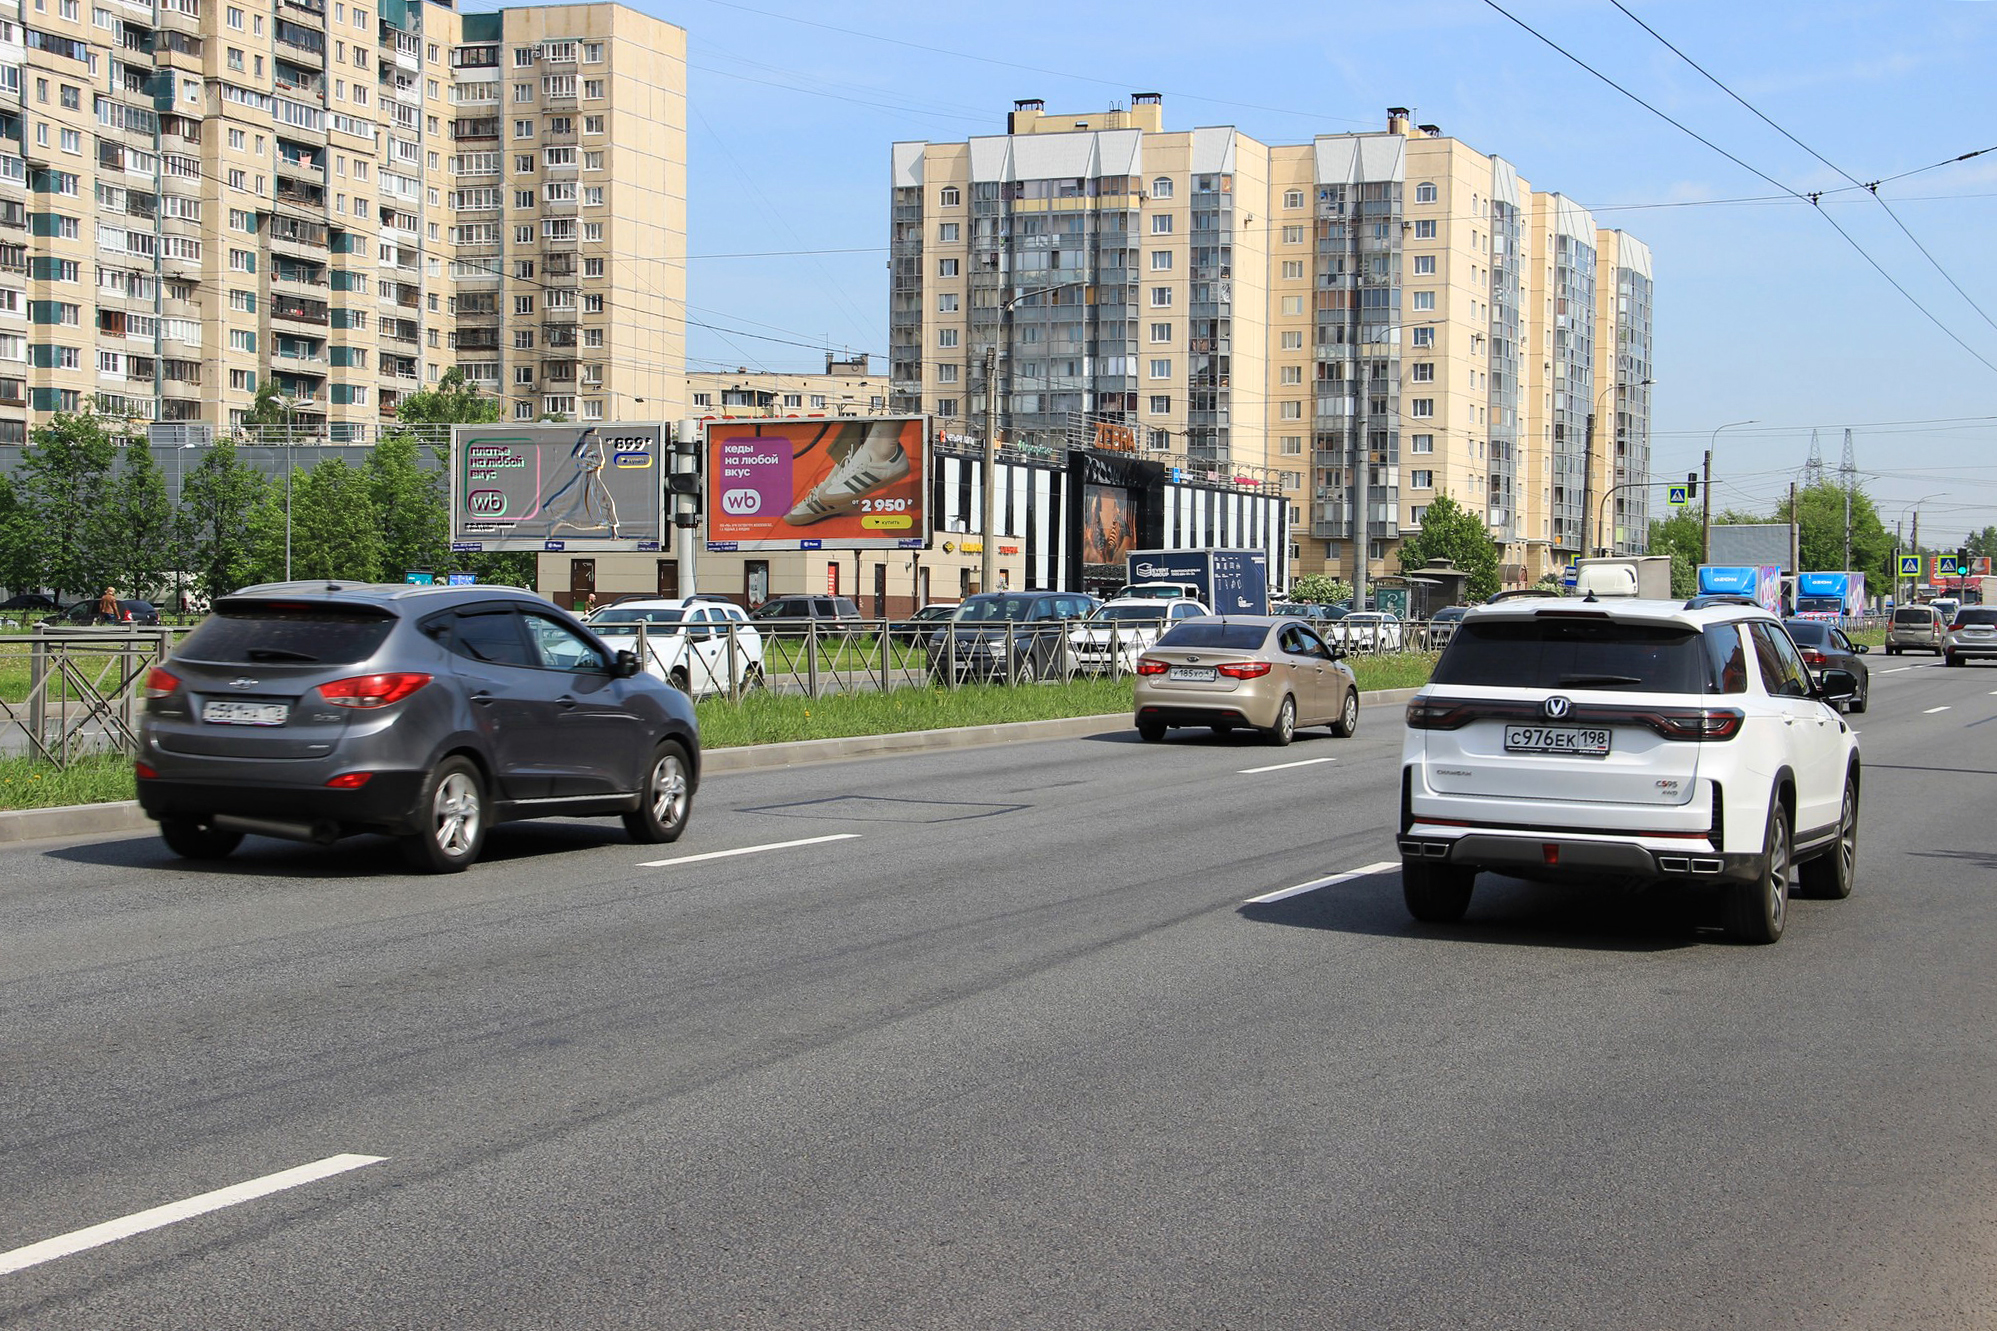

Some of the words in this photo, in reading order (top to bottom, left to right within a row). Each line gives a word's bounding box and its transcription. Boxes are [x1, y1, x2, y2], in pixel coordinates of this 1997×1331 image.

[614, 437, 645, 451] 899
[1093, 423, 1136, 453] ZEBRA
[470, 446, 511, 456] платье
[724, 445, 754, 454] кеды
[470, 458, 486, 468] на
[486, 456, 525, 468] любой
[725, 457, 739, 465] на
[741, 454, 779, 465] любой
[470, 469, 498, 481] вкус
[724, 468, 751, 478] вкус
[473, 492, 502, 511] wb
[727, 491, 756, 509] wb
[861, 499, 872, 512] 2
[874, 499, 906, 512] 950
[1580, 731, 1606, 745] 198
